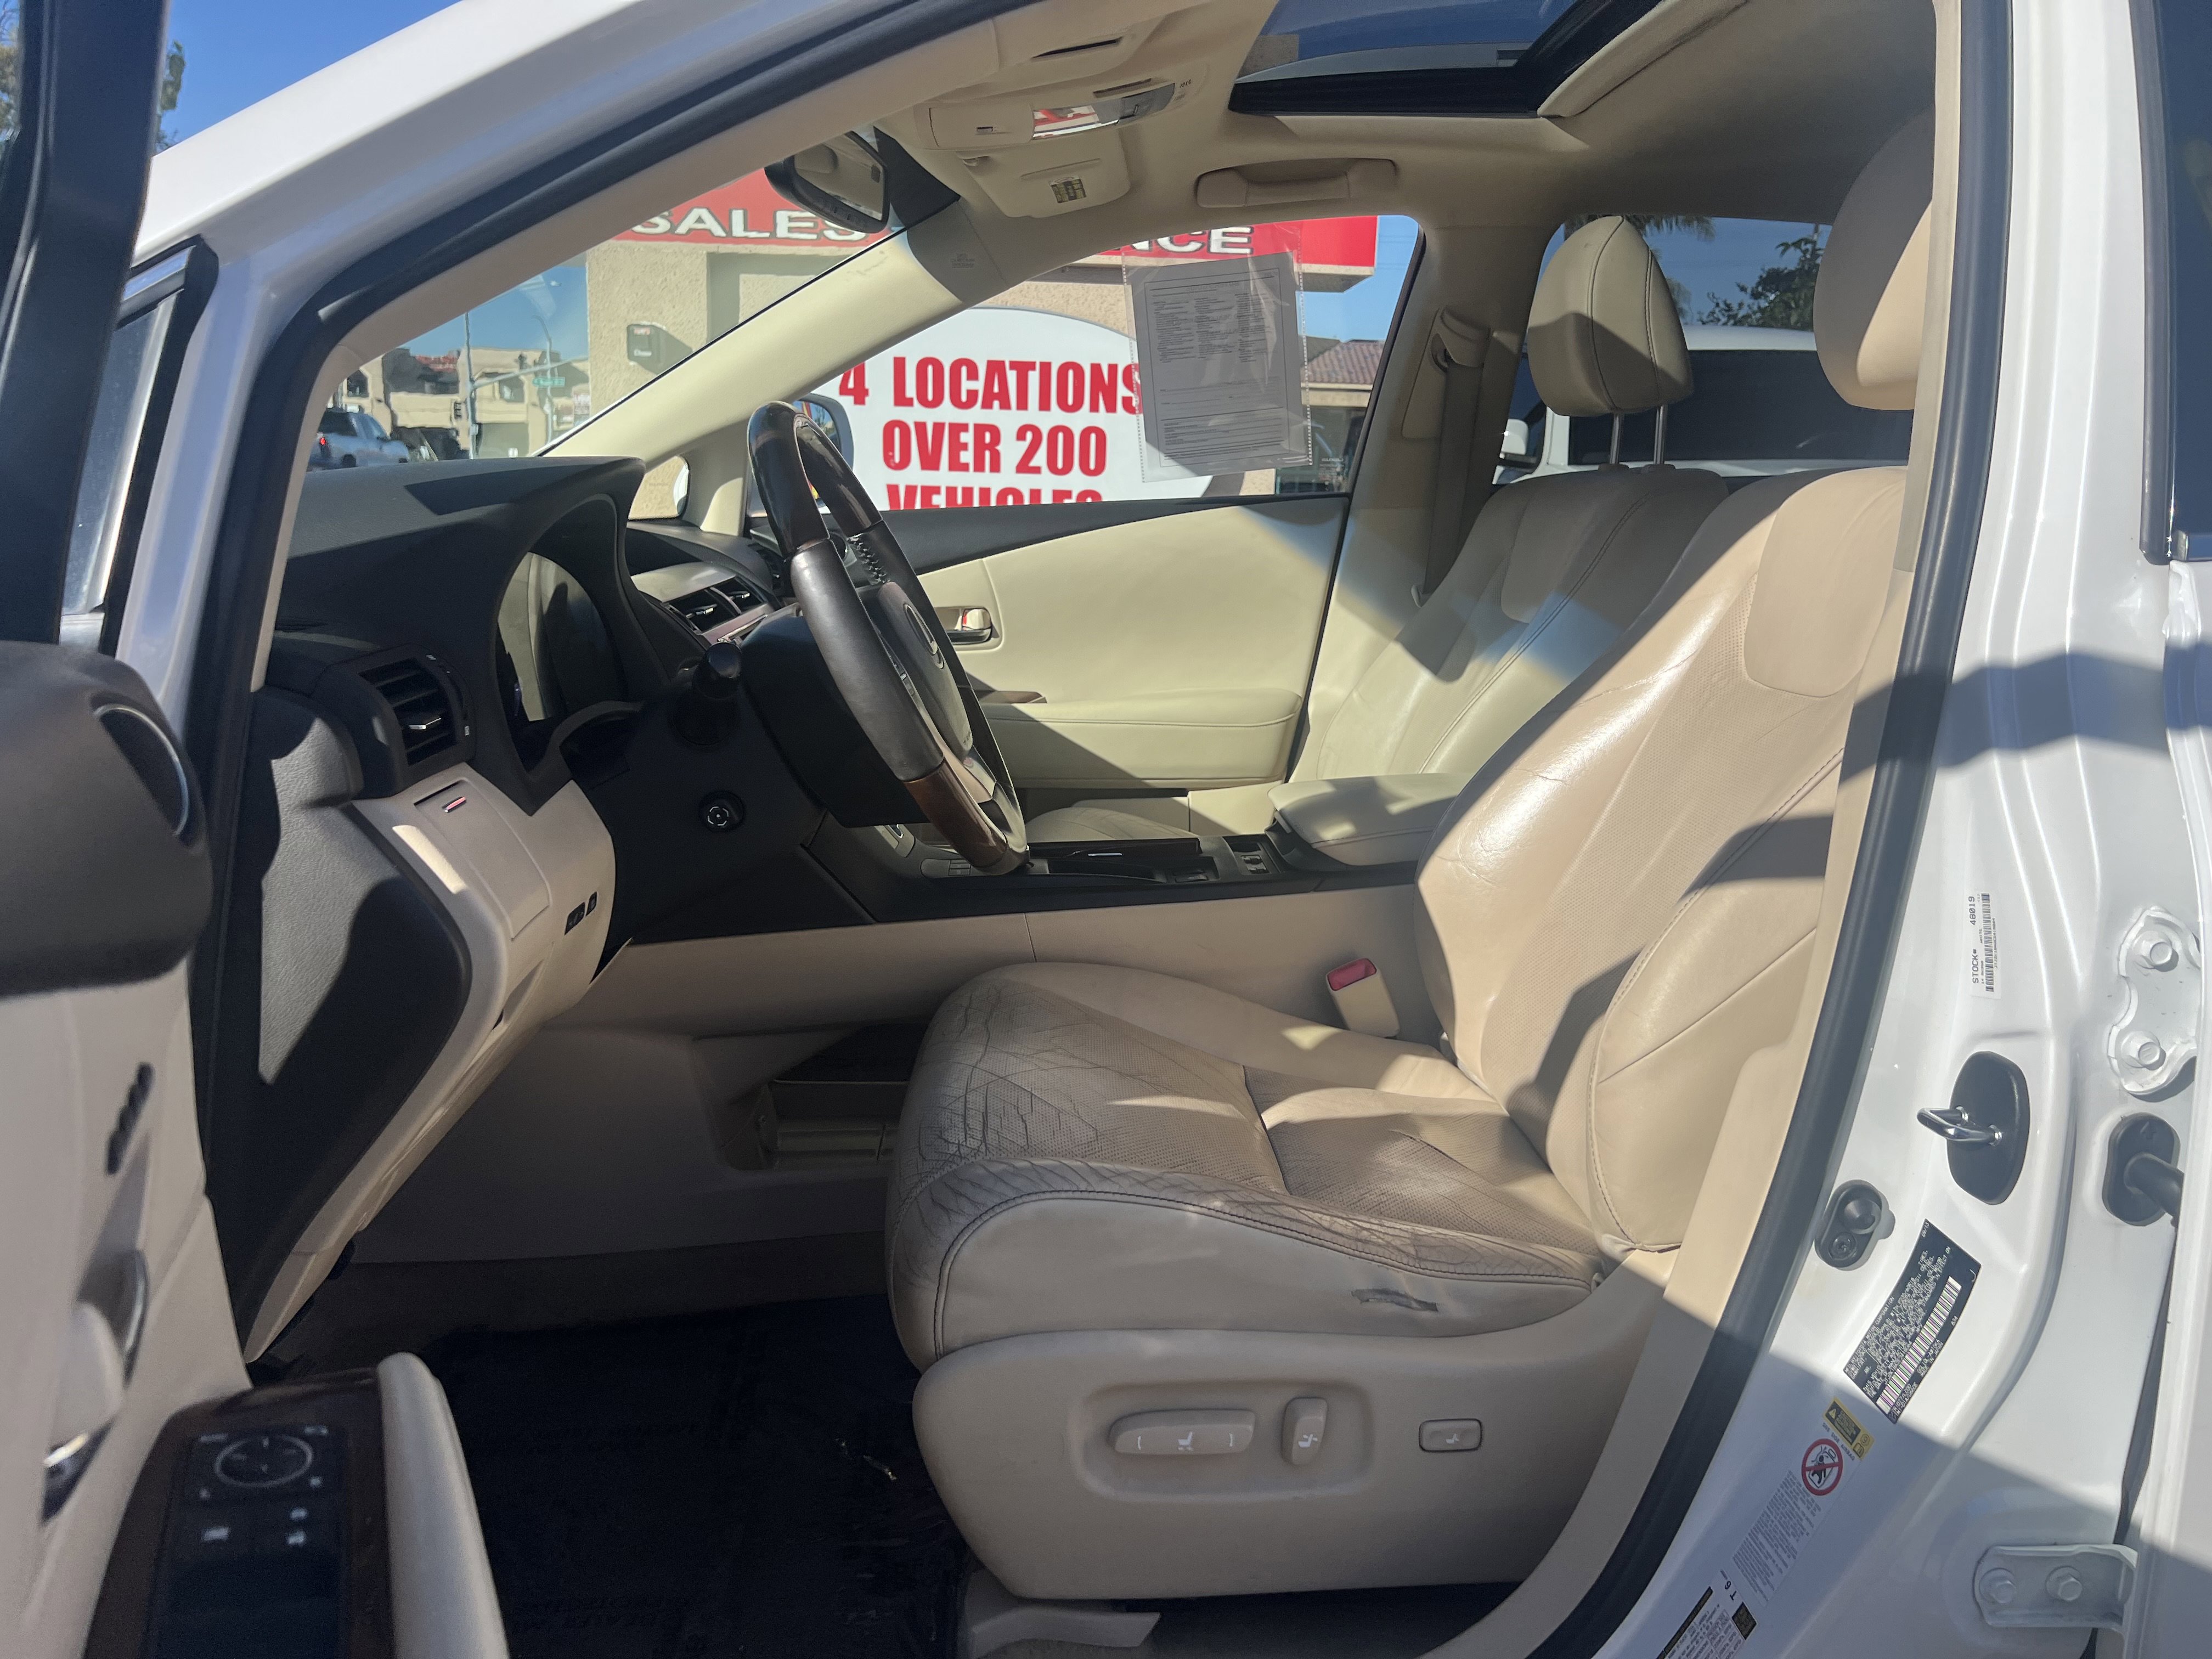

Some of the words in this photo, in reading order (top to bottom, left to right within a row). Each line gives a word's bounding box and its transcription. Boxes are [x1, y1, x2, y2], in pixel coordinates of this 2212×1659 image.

[839, 362, 869, 405] 4
[893, 357, 1143, 415] LOCATIONS
[883, 420, 1001, 474] OVER
[1015, 424, 1107, 477] 200
